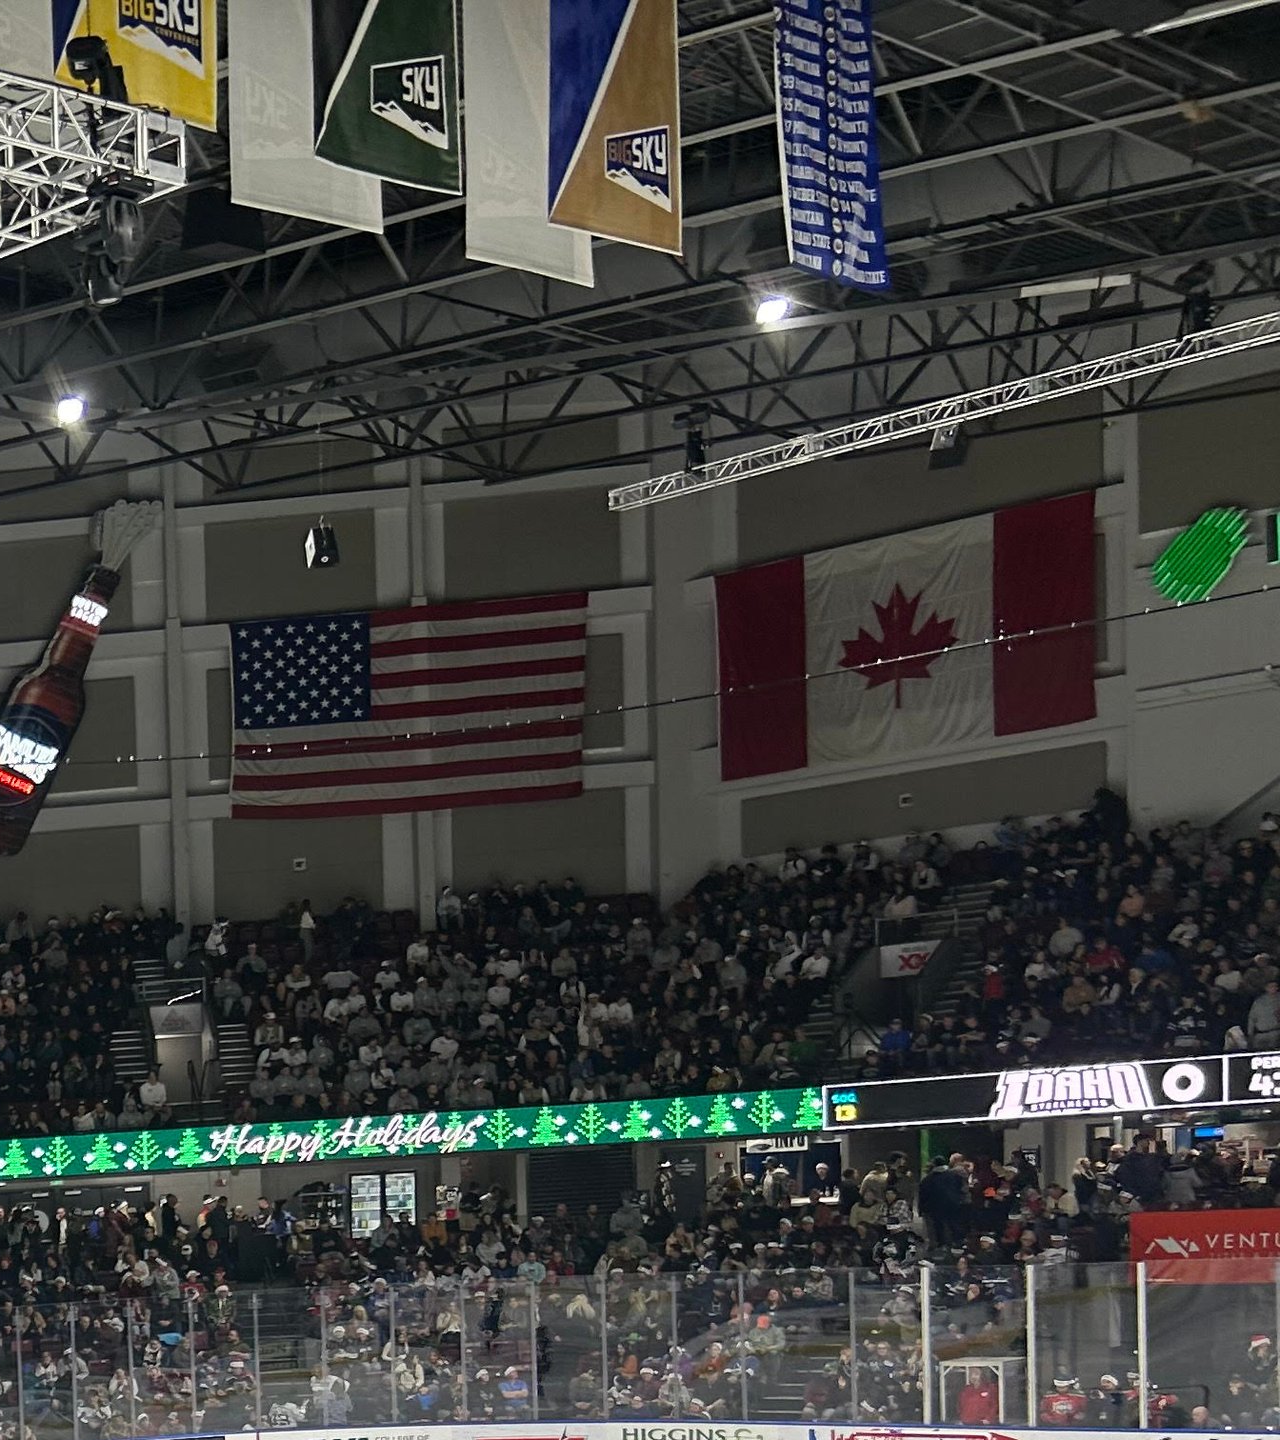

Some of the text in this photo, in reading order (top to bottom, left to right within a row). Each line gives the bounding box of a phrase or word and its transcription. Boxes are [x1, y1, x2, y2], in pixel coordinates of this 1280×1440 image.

[401, 67, 439, 111] SKY
[831, 1091, 857, 1104] SOG
[990, 1065, 1152, 1119] IDAHO
[1162, 1063, 1207, 1103] 0
[206, 1111, 483, 1164] Happy Holidays
